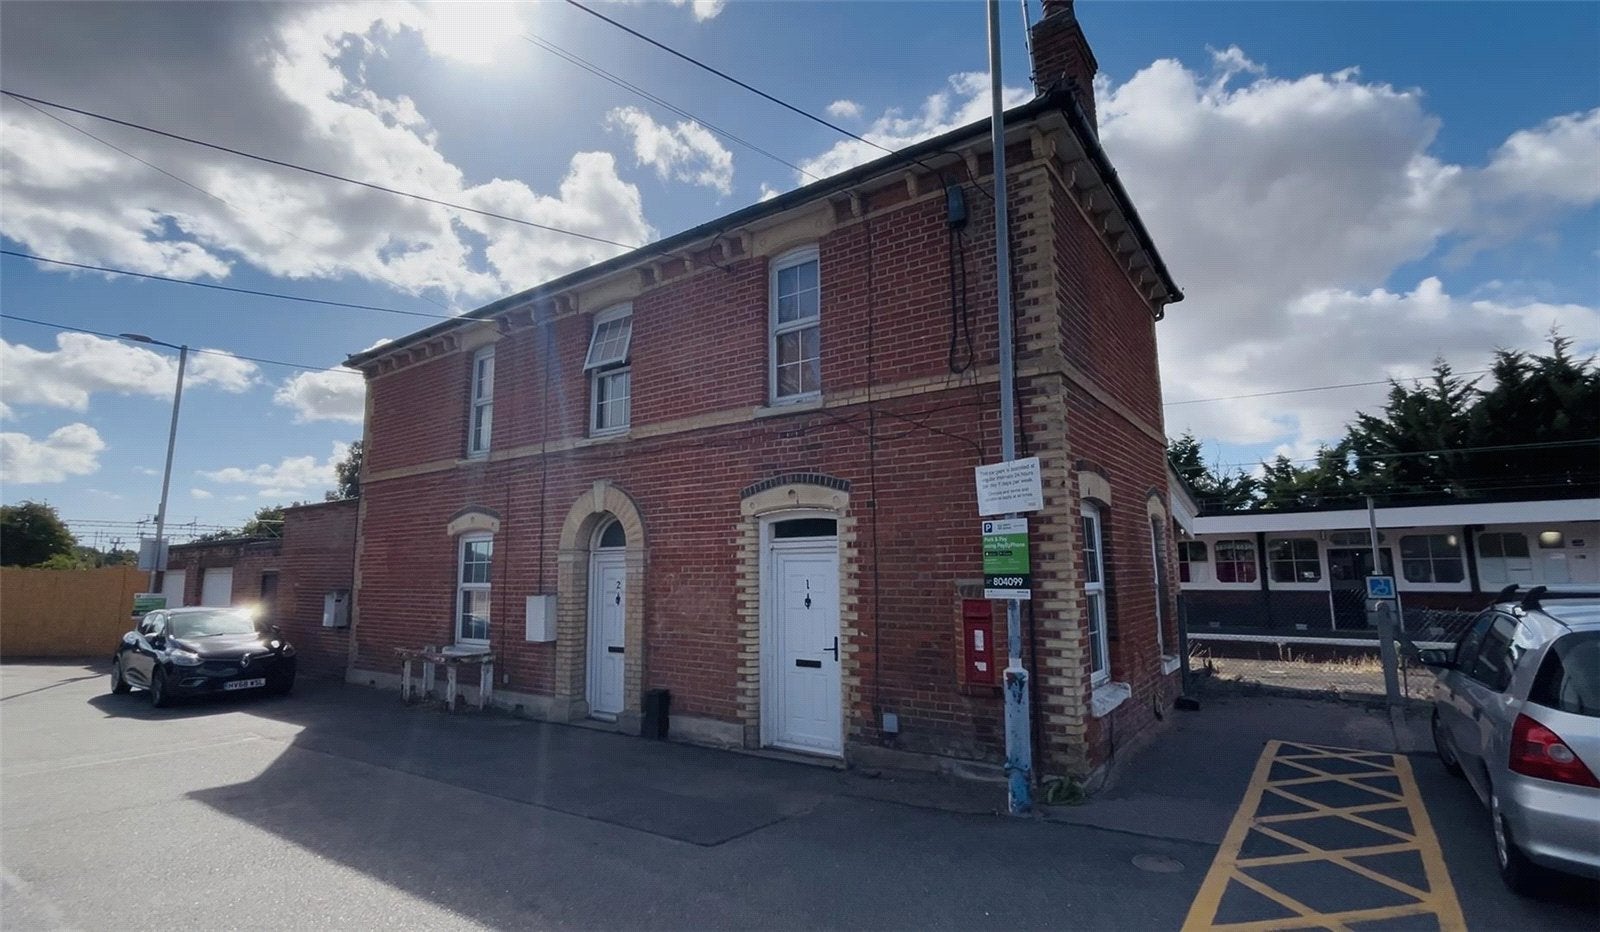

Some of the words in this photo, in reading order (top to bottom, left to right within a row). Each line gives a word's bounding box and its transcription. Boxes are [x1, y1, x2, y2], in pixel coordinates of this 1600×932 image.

[616, 580, 621, 589] 2
[806, 579, 810, 589] 1
[993, 577, 1023, 586] 804099
